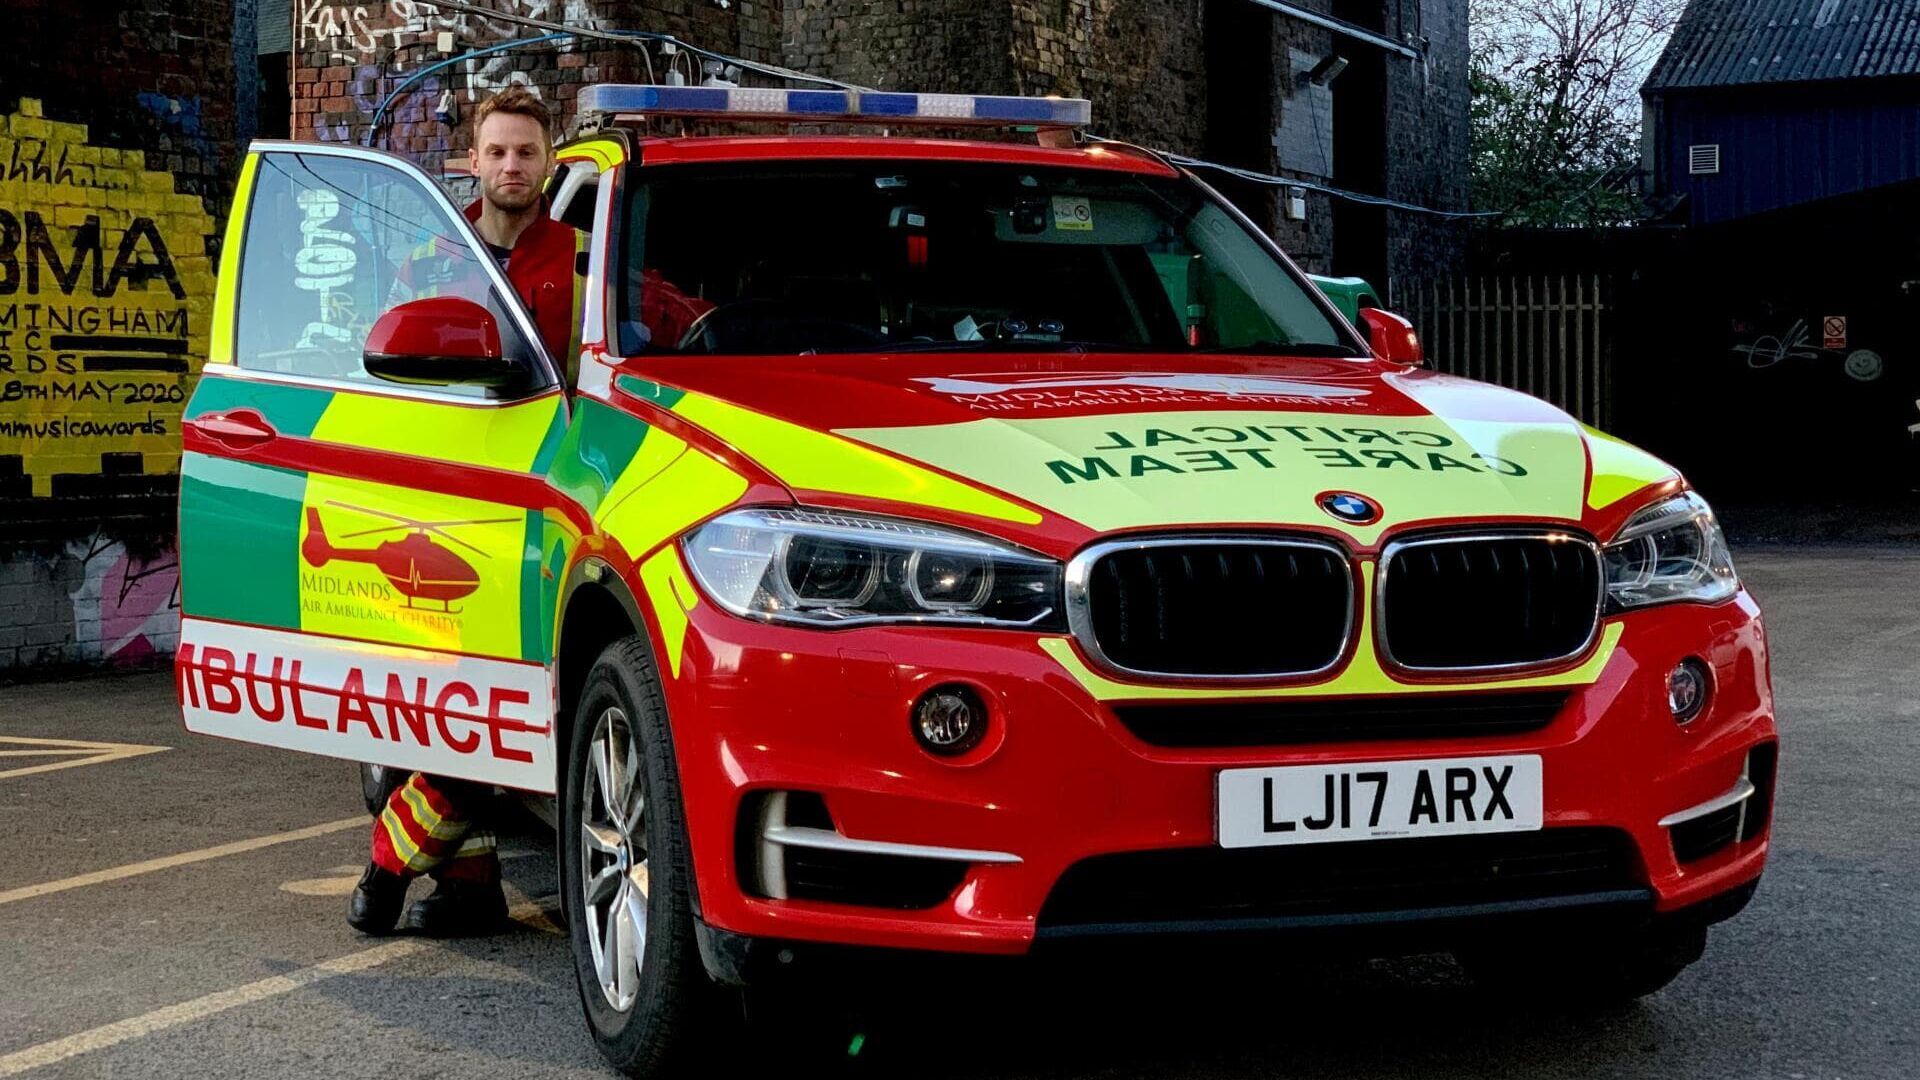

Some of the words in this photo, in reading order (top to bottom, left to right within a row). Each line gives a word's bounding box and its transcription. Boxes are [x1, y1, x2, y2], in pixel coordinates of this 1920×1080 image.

[52, 380, 119, 403] MAY
[123, 383, 186, 404] 2020
[951, 387, 1185, 403] MIDLANDS
[968, 402, 1025, 411] AIR
[1032, 394, 1218, 409] AMBULANCE
[301, 572, 392, 601] MIDLANDS
[301, 598, 322, 614] AIR
[1262, 771, 1389, 834] LJ17
[1408, 764, 1515, 825] ARX
